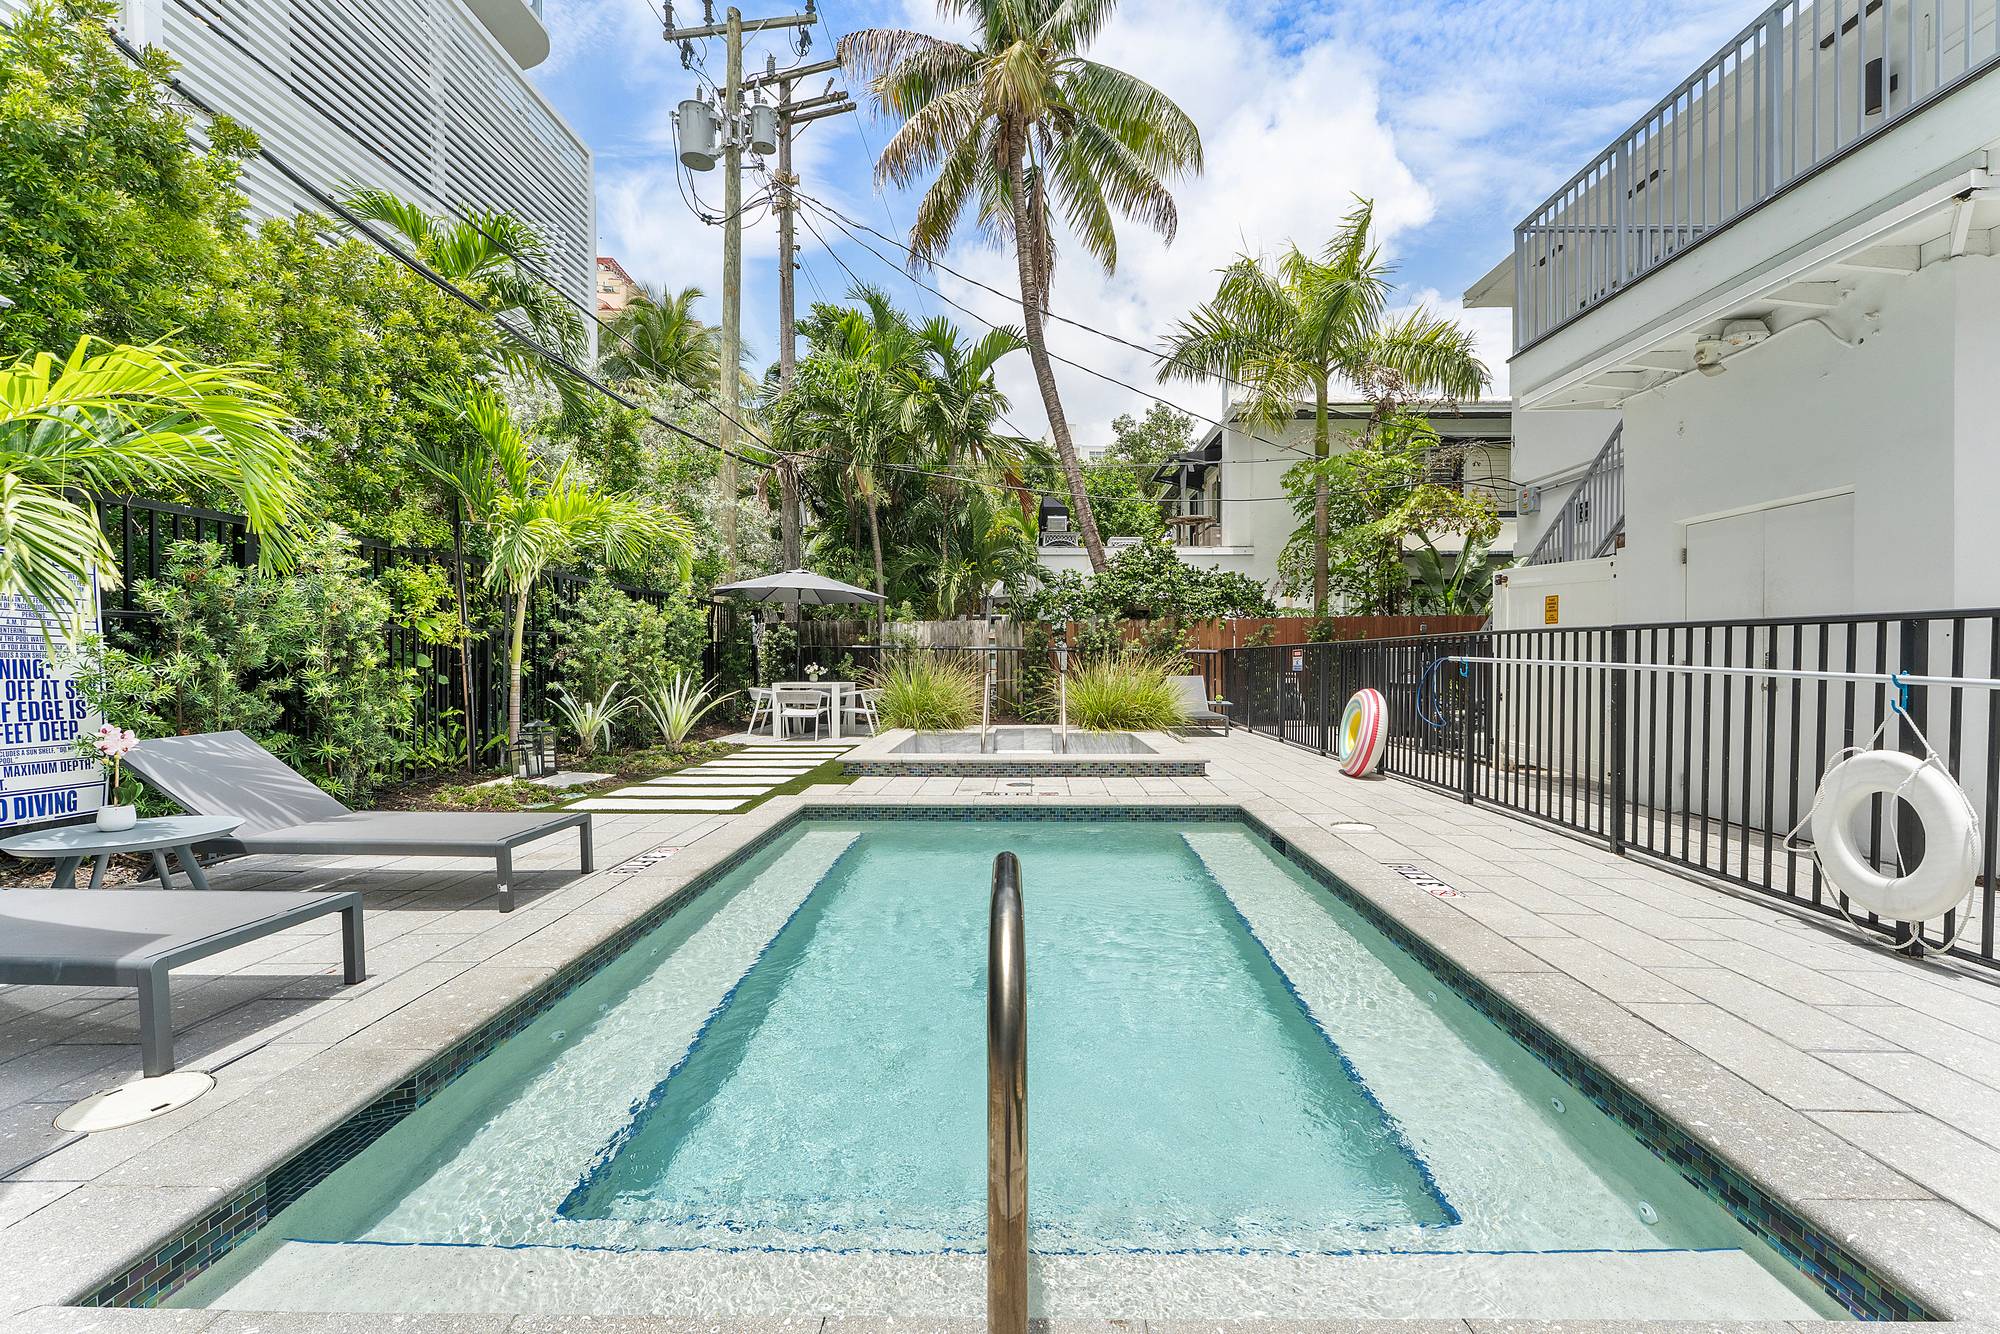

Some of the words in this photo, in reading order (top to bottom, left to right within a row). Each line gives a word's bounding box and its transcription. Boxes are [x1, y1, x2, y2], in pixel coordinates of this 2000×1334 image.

[6, 680, 35, 701] OFF
[41, 680, 59, 700] AT
[17, 700, 64, 722] EDGE
[69, 700, 86, 719] IS
[39, 720, 81, 742] DEEP.
[3, 762, 58, 778] MAXIMUM
[60, 759, 94, 772] DEPTH:
[14, 790, 78, 819] DIVING
